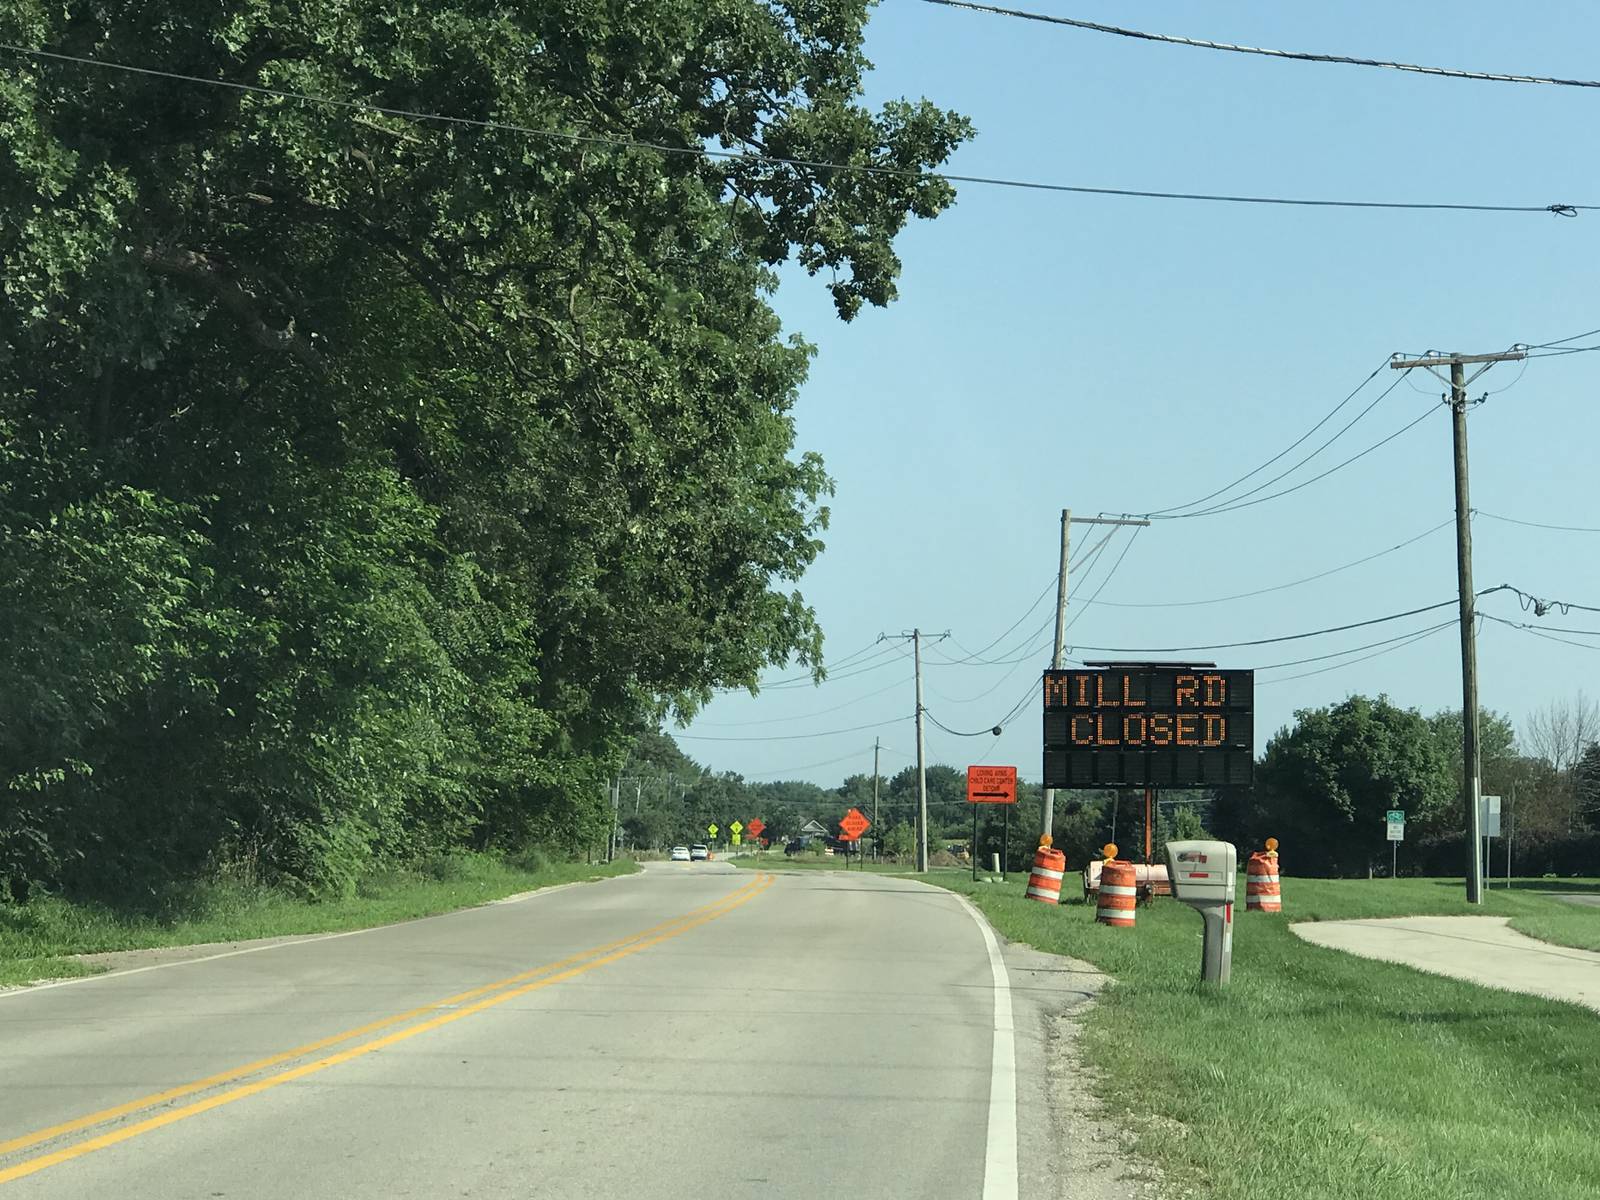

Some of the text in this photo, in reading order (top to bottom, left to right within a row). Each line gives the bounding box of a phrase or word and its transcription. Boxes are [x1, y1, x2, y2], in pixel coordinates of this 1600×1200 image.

[1045, 675, 1226, 707] MILL RD
[1071, 714, 1226, 745] CLOSED
